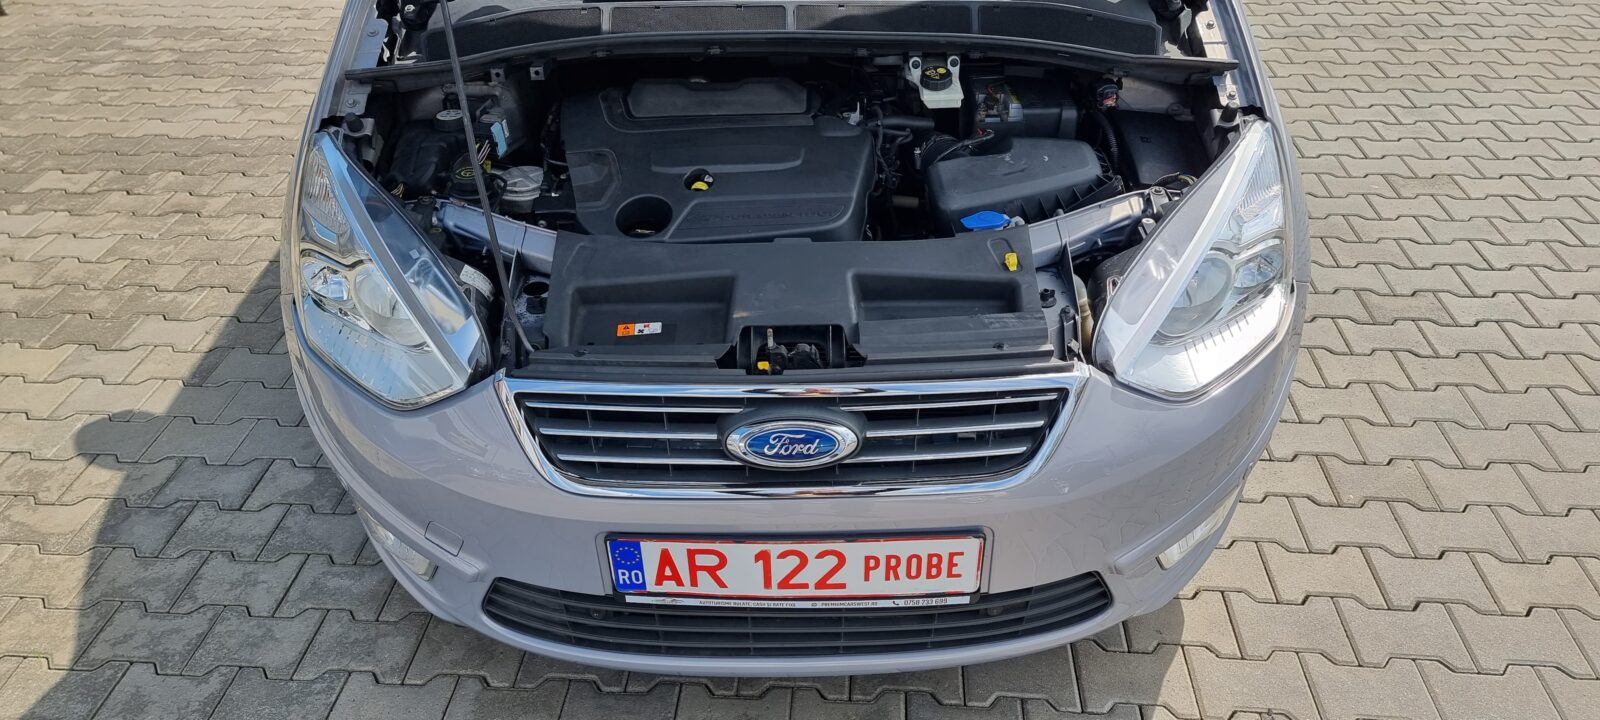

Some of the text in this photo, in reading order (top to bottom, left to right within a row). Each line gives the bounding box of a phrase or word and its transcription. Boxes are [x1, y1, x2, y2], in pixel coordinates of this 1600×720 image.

[764, 433, 819, 455] Ford
[617, 569, 643, 584] RO
[654, 547, 965, 590] AR 122 PROBE
